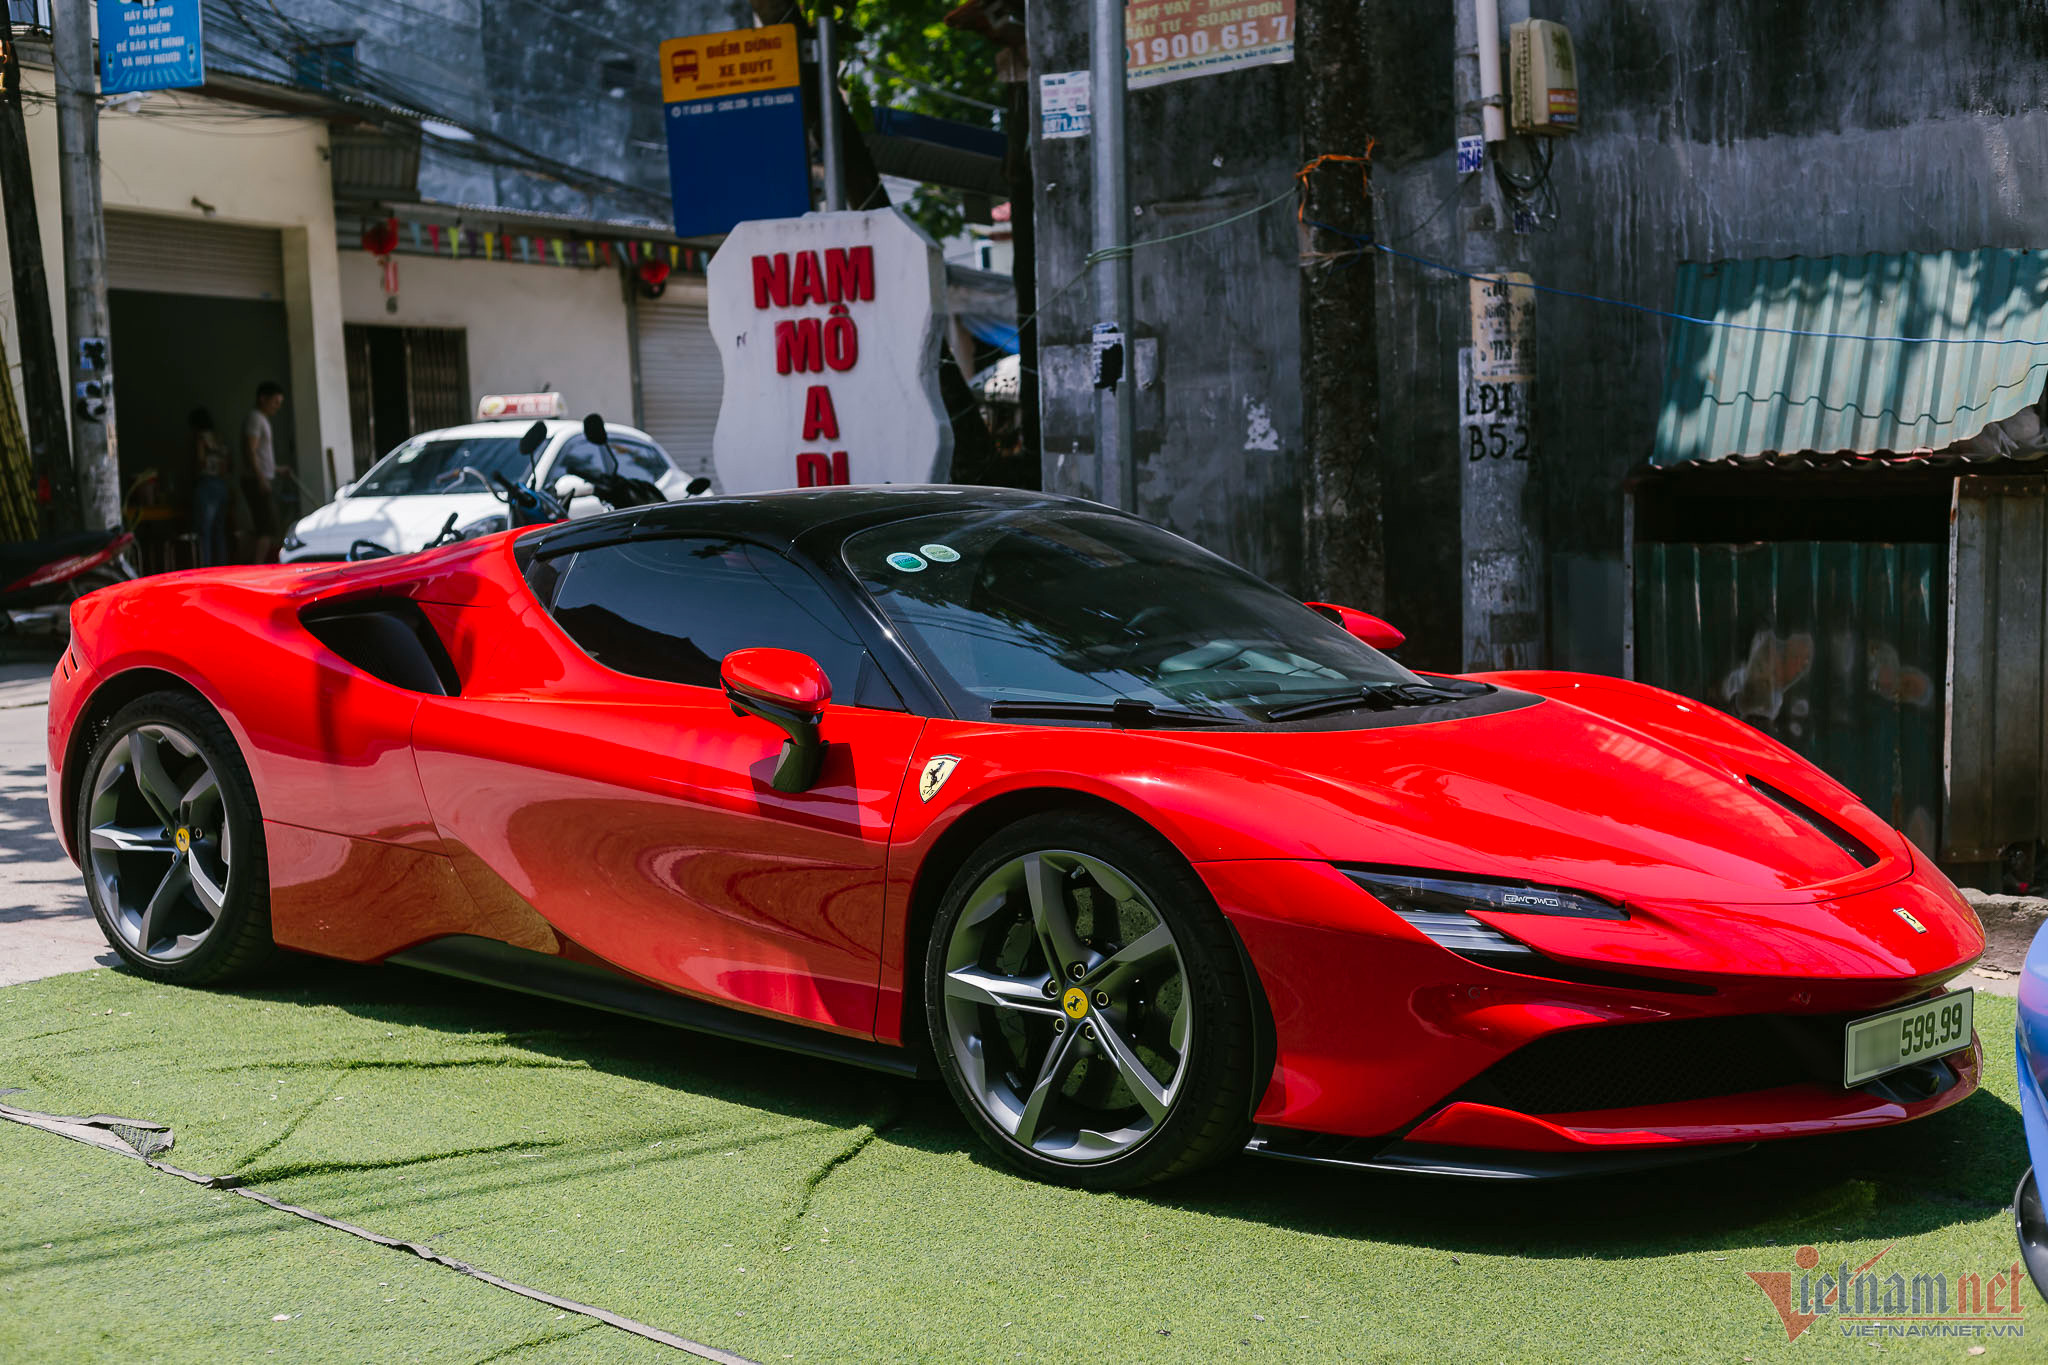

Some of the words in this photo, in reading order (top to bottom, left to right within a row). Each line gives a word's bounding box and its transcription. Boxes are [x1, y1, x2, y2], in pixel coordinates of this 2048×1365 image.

[1163, 1, 1191, 15] VAY
[719, 63, 736, 78] XE
[751, 245, 876, 310] NAM
[774, 302, 859, 376] MÔ
[802, 384, 840, 442] A
[1901, 1002, 1963, 1056] 599.99
